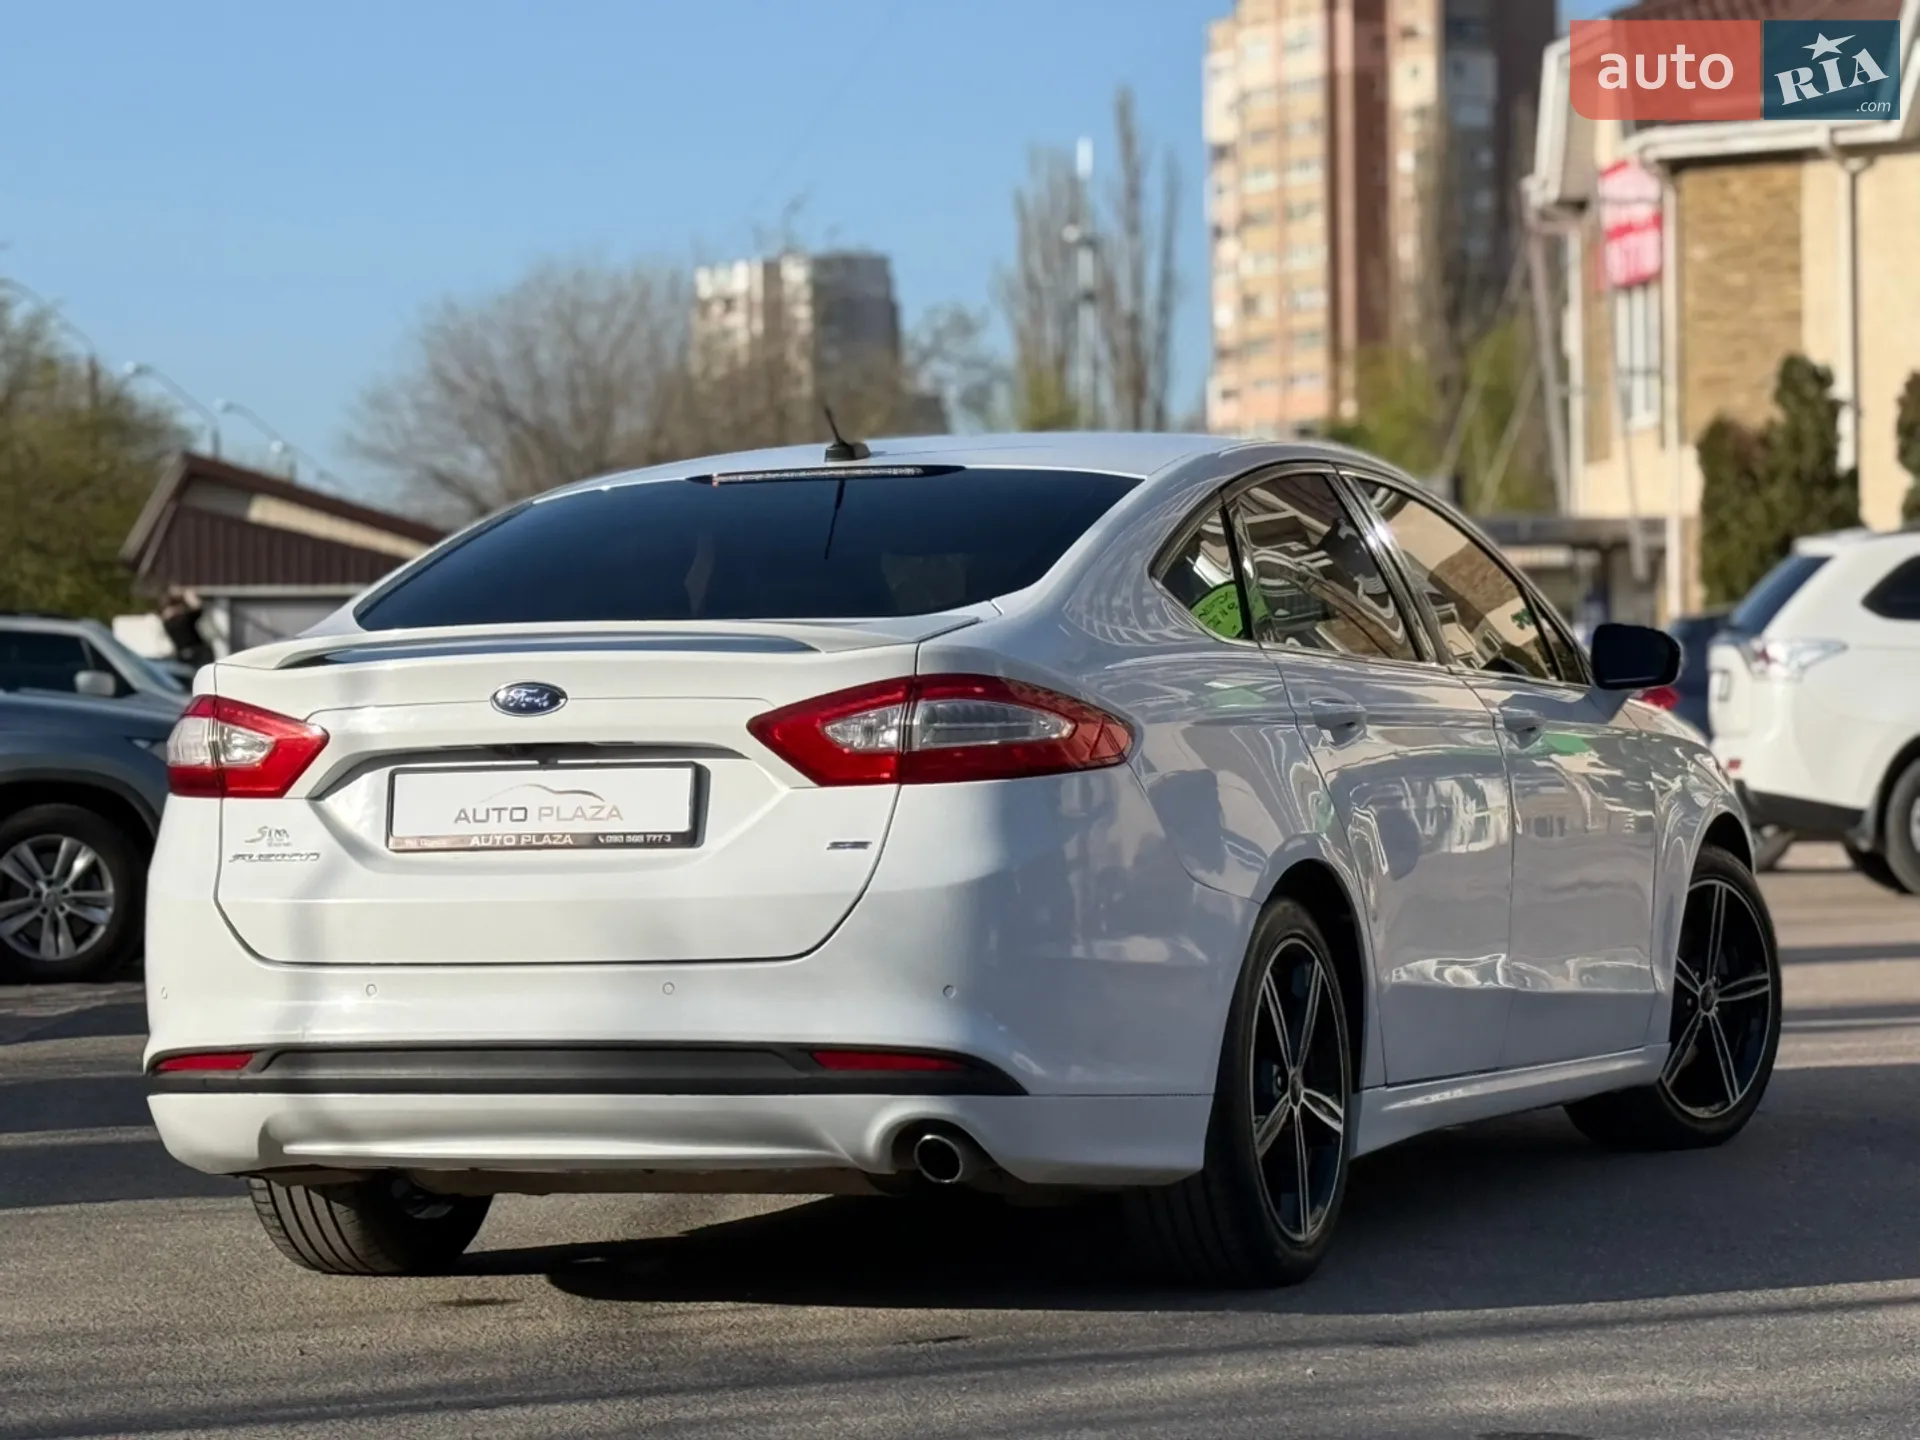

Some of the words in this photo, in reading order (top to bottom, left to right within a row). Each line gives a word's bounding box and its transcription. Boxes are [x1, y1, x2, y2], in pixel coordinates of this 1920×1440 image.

[454, 806, 528, 824] AUTO
[538, 804, 624, 822] PLAZA
[469, 834, 516, 847] AUTO
[520, 833, 574, 846] PLAZA
